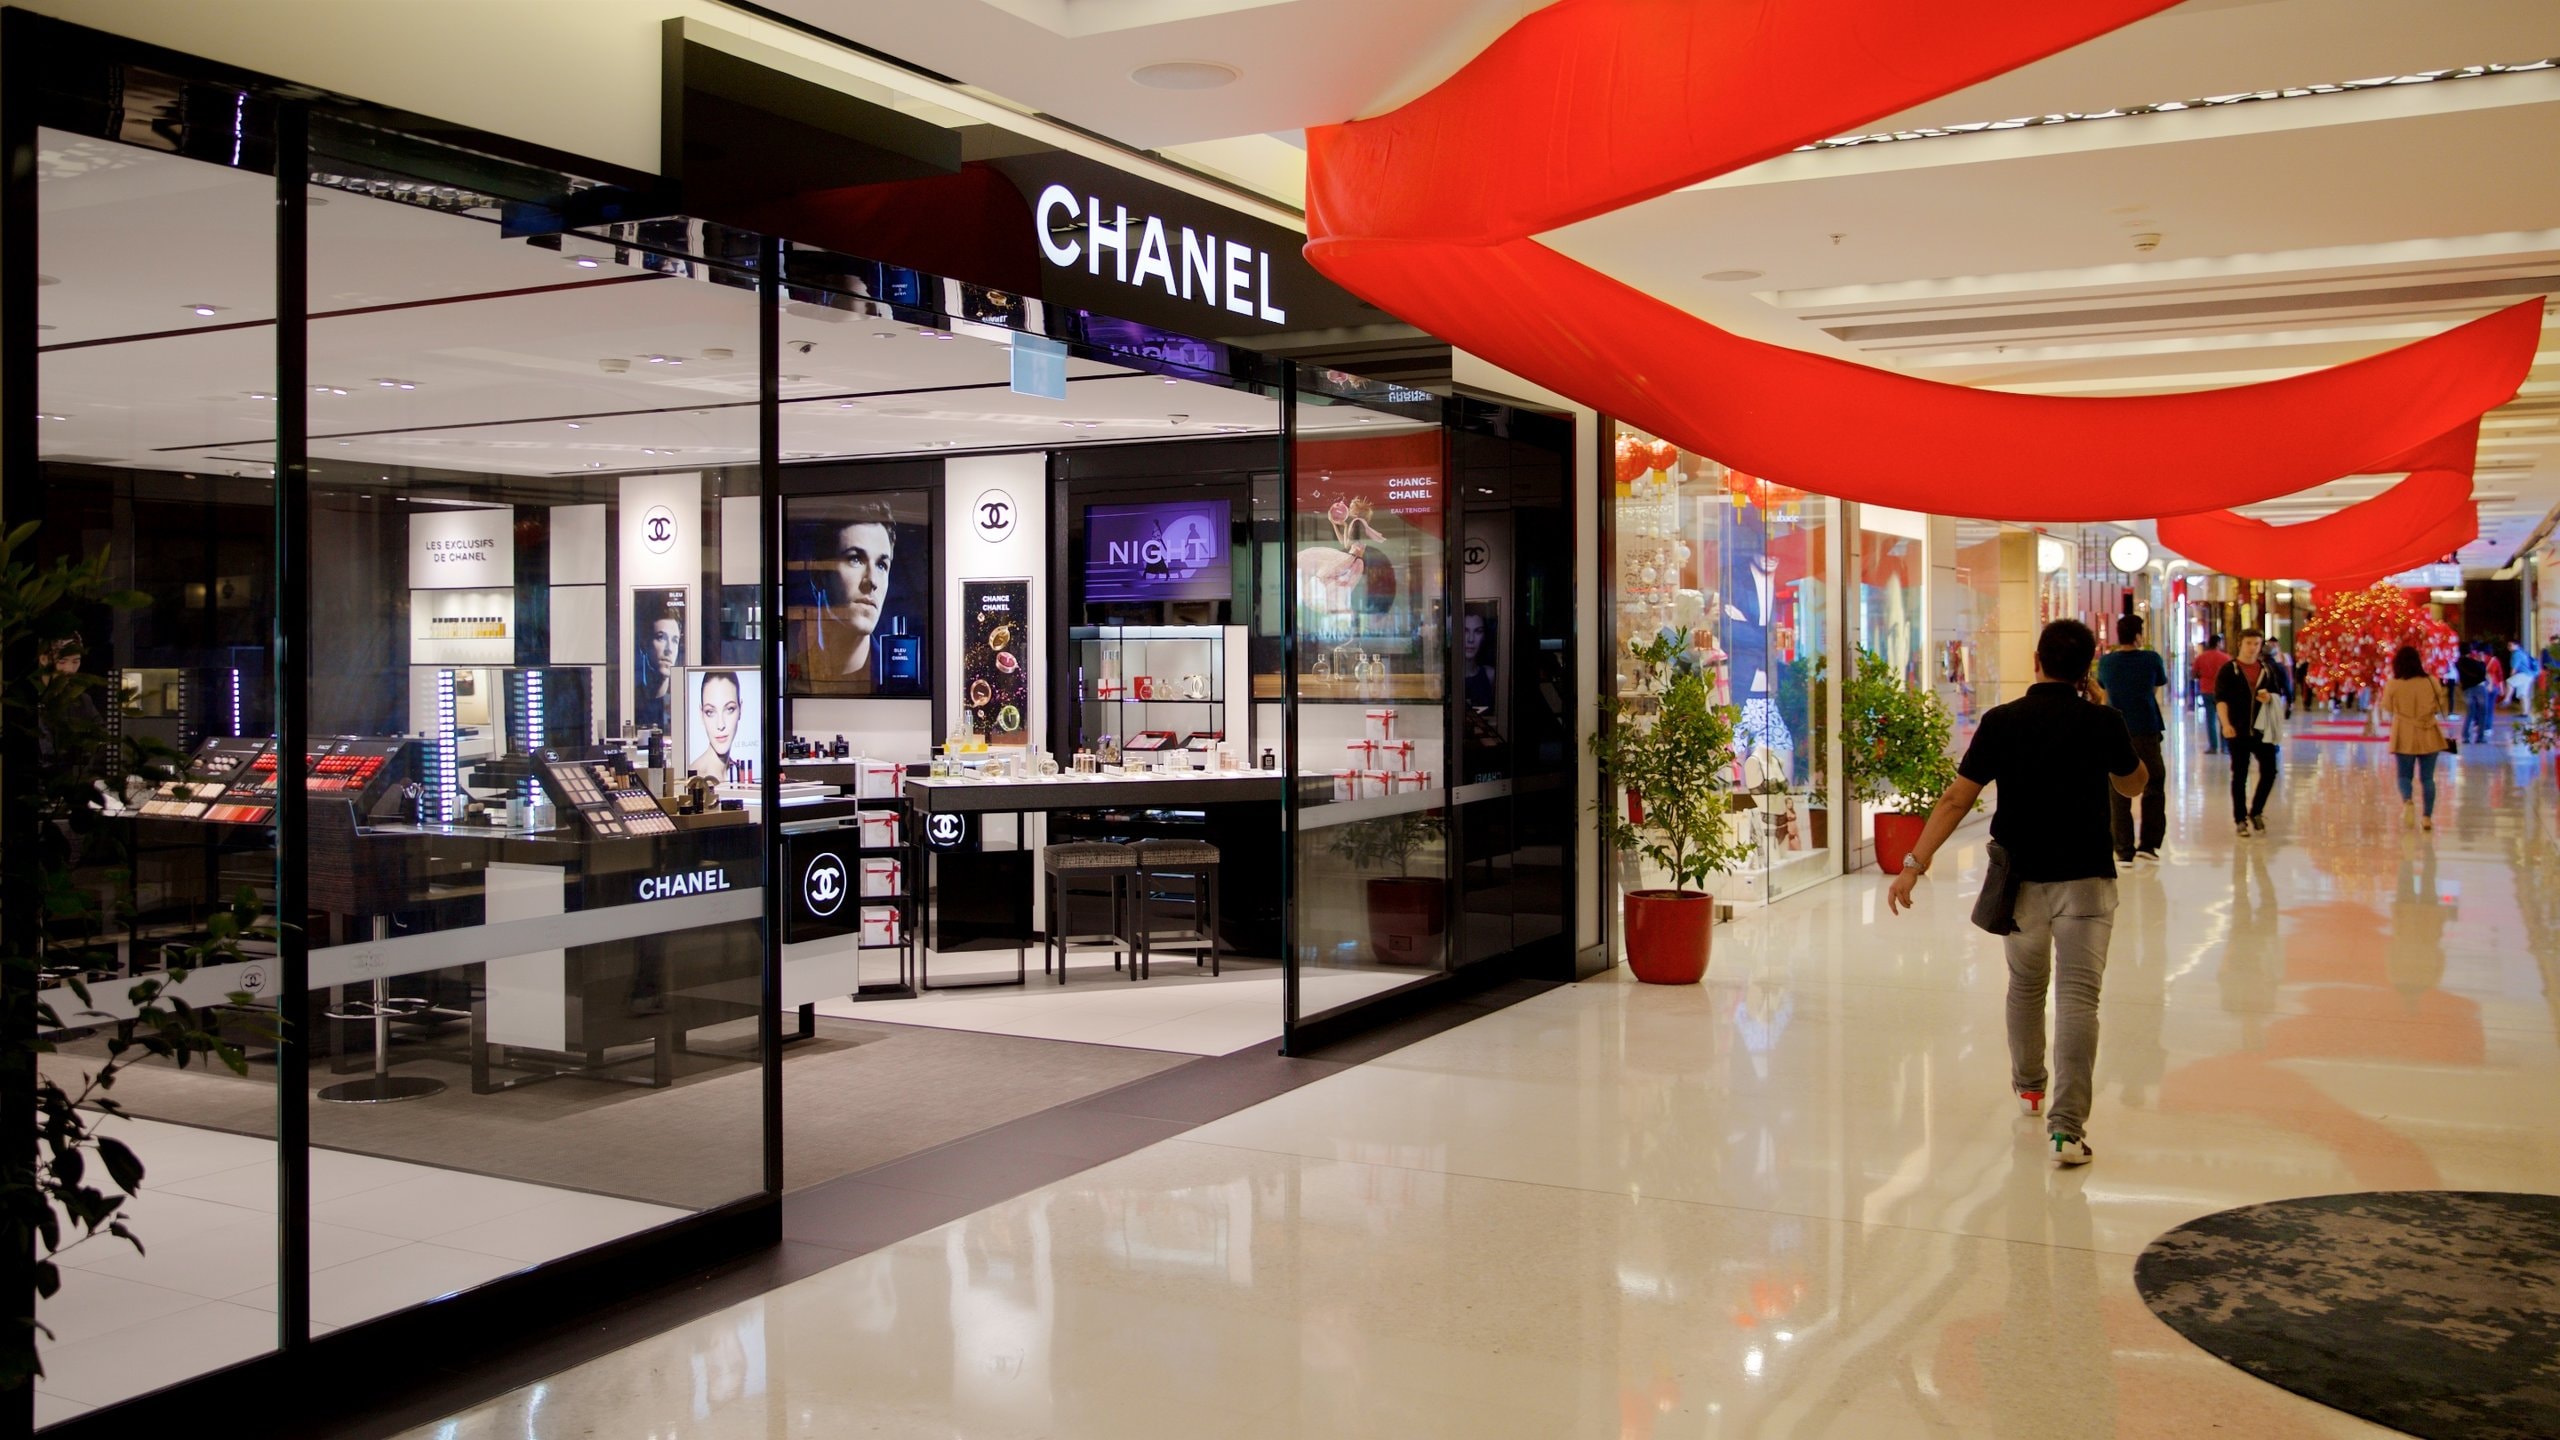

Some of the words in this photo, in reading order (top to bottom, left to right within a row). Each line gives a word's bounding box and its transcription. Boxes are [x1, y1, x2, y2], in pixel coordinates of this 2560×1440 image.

[1037, 185, 1285, 325] CHANEL
[1388, 477, 1432, 488] CHANCE
[1389, 489, 1432, 500] CHANEL
[426, 541, 442, 551] LES
[445, 539, 494, 549] EXCLUSIFS
[434, 553, 446, 562] DE
[449, 552, 486, 561] CHANEL
[1109, 538, 1207, 565] NIGHT
[639, 869, 730, 900] CHANEL
